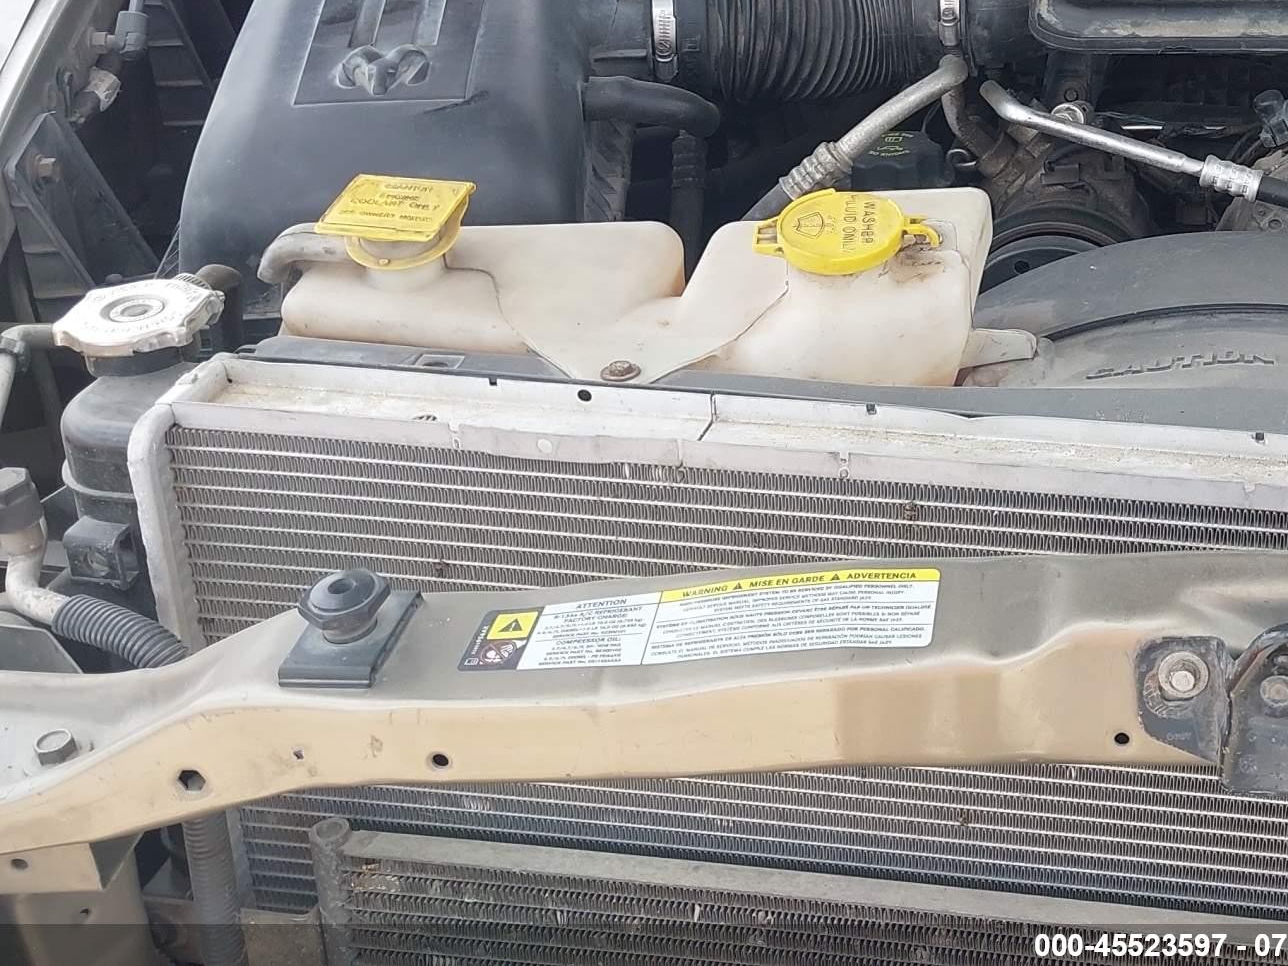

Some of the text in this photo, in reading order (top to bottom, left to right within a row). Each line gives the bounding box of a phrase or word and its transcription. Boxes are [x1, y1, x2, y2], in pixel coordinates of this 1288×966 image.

[842, 194, 857, 253] FLUID ONLY
[861, 201, 876, 244] WASHER
[1085, 350, 1276, 380] CAUTION
[682, 585, 728, 598] WARNING
[749, 579, 774, 588] MISE
[776, 578, 790, 586] EN
[792, 575, 825, 584] GARDE
[576, 598, 627, 609] ATTENTION
